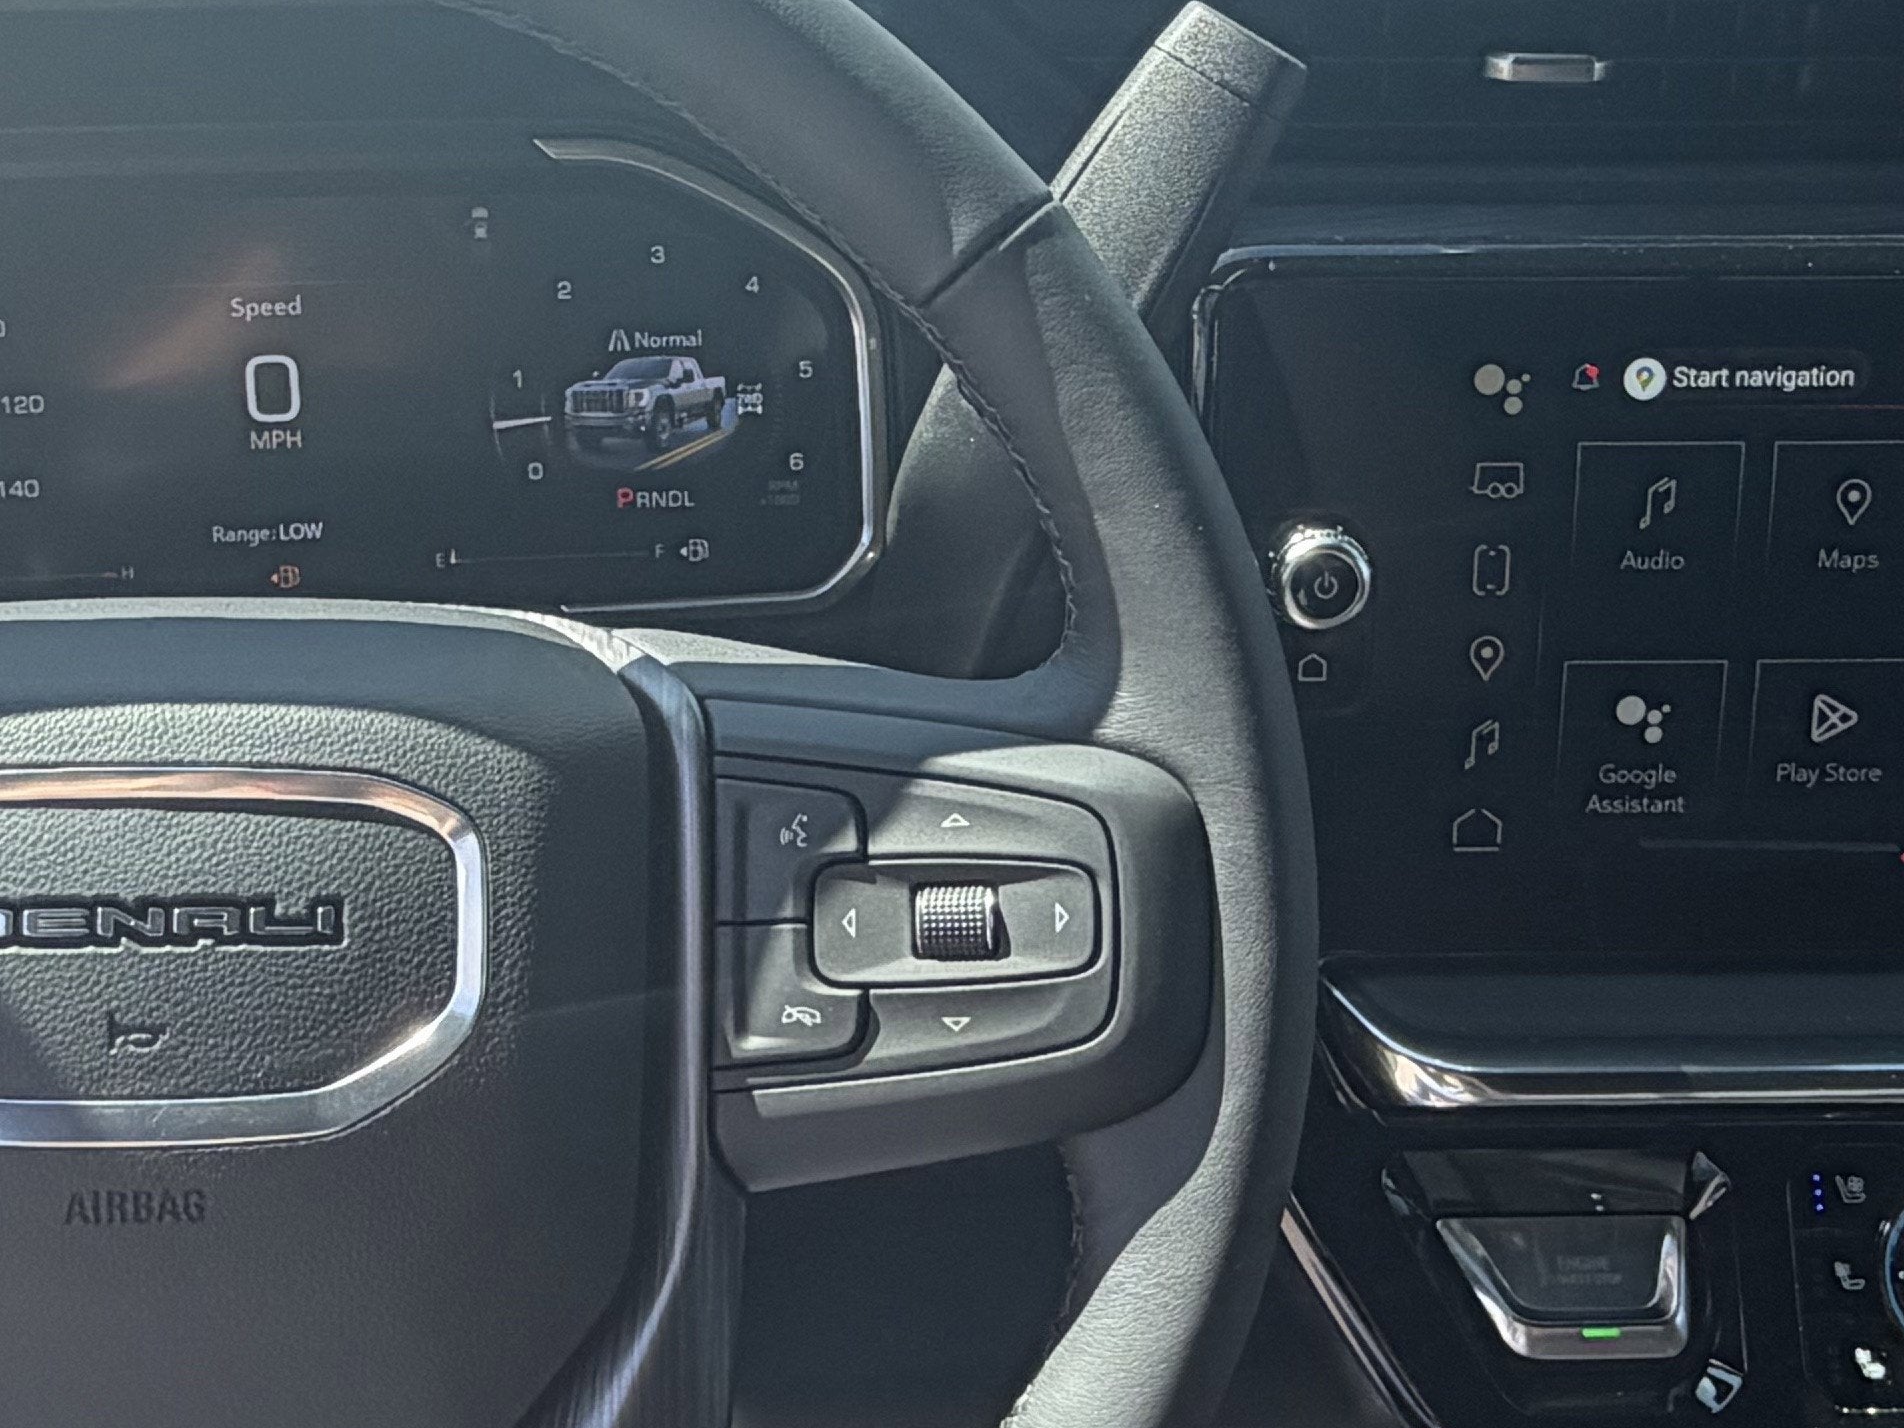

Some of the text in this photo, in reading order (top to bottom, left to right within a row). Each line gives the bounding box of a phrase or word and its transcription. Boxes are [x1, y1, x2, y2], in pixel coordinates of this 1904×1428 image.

[649, 245, 666, 264] 3
[557, 280, 573, 300] 2
[745, 275, 760, 294] 4
[229, 294, 303, 322] Speed
[634, 328, 703, 349] Normal
[512, 369, 524, 389] 1
[798, 361, 814, 379] 5
[1672, 365, 1856, 392] Start navigation
[245, 353, 302, 423] 0
[0, 394, 45, 415] 120
[249, 428, 303, 451] MPH
[527, 461, 544, 480] 0
[788, 452, 805, 471] 6
[211, 521, 324, 548] Range: LOW
[1619, 549, 1685, 572] Audio
[1817, 549, 1880, 573] Maps
[1598, 762, 1678, 790] Google
[1775, 762, 1883, 789] Play Store
[1584, 794, 1686, 815] Assistant
[63, 1187, 209, 1227] AIRBAG
